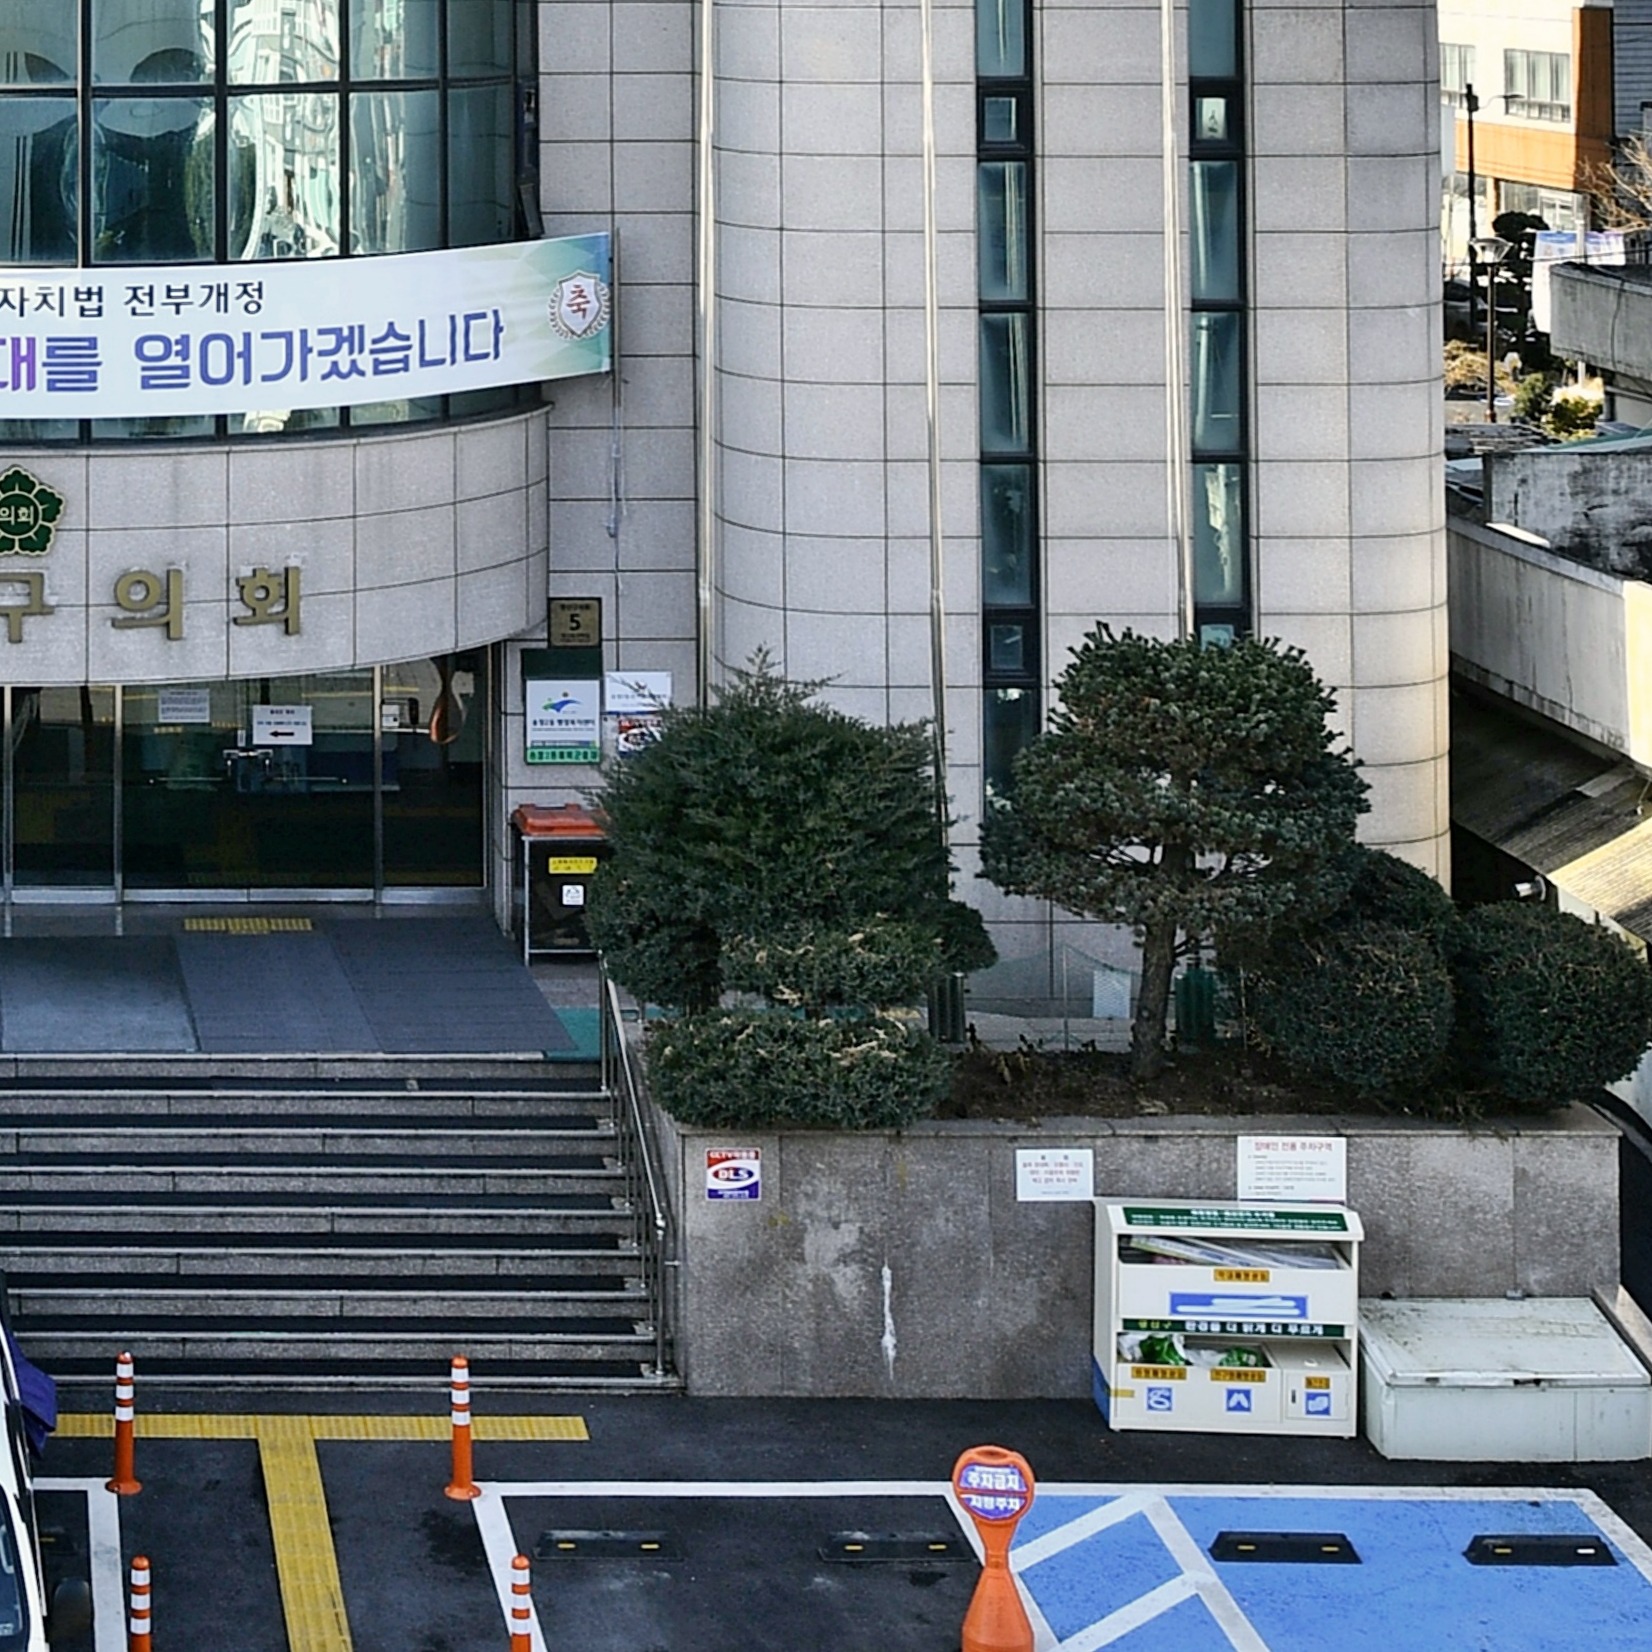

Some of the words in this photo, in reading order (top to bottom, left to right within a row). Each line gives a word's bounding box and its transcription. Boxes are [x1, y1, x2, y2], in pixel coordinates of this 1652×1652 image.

[123, 281, 264, 318] 전부개정
[566, 283, 592, 321] 축
[133, 307, 505, 392] 열어가겠습니다
[568, 613, 582, 631] 5
[718, 1169, 750, 1180] DLS
[968, 1471, 1020, 1491] 주차금지
